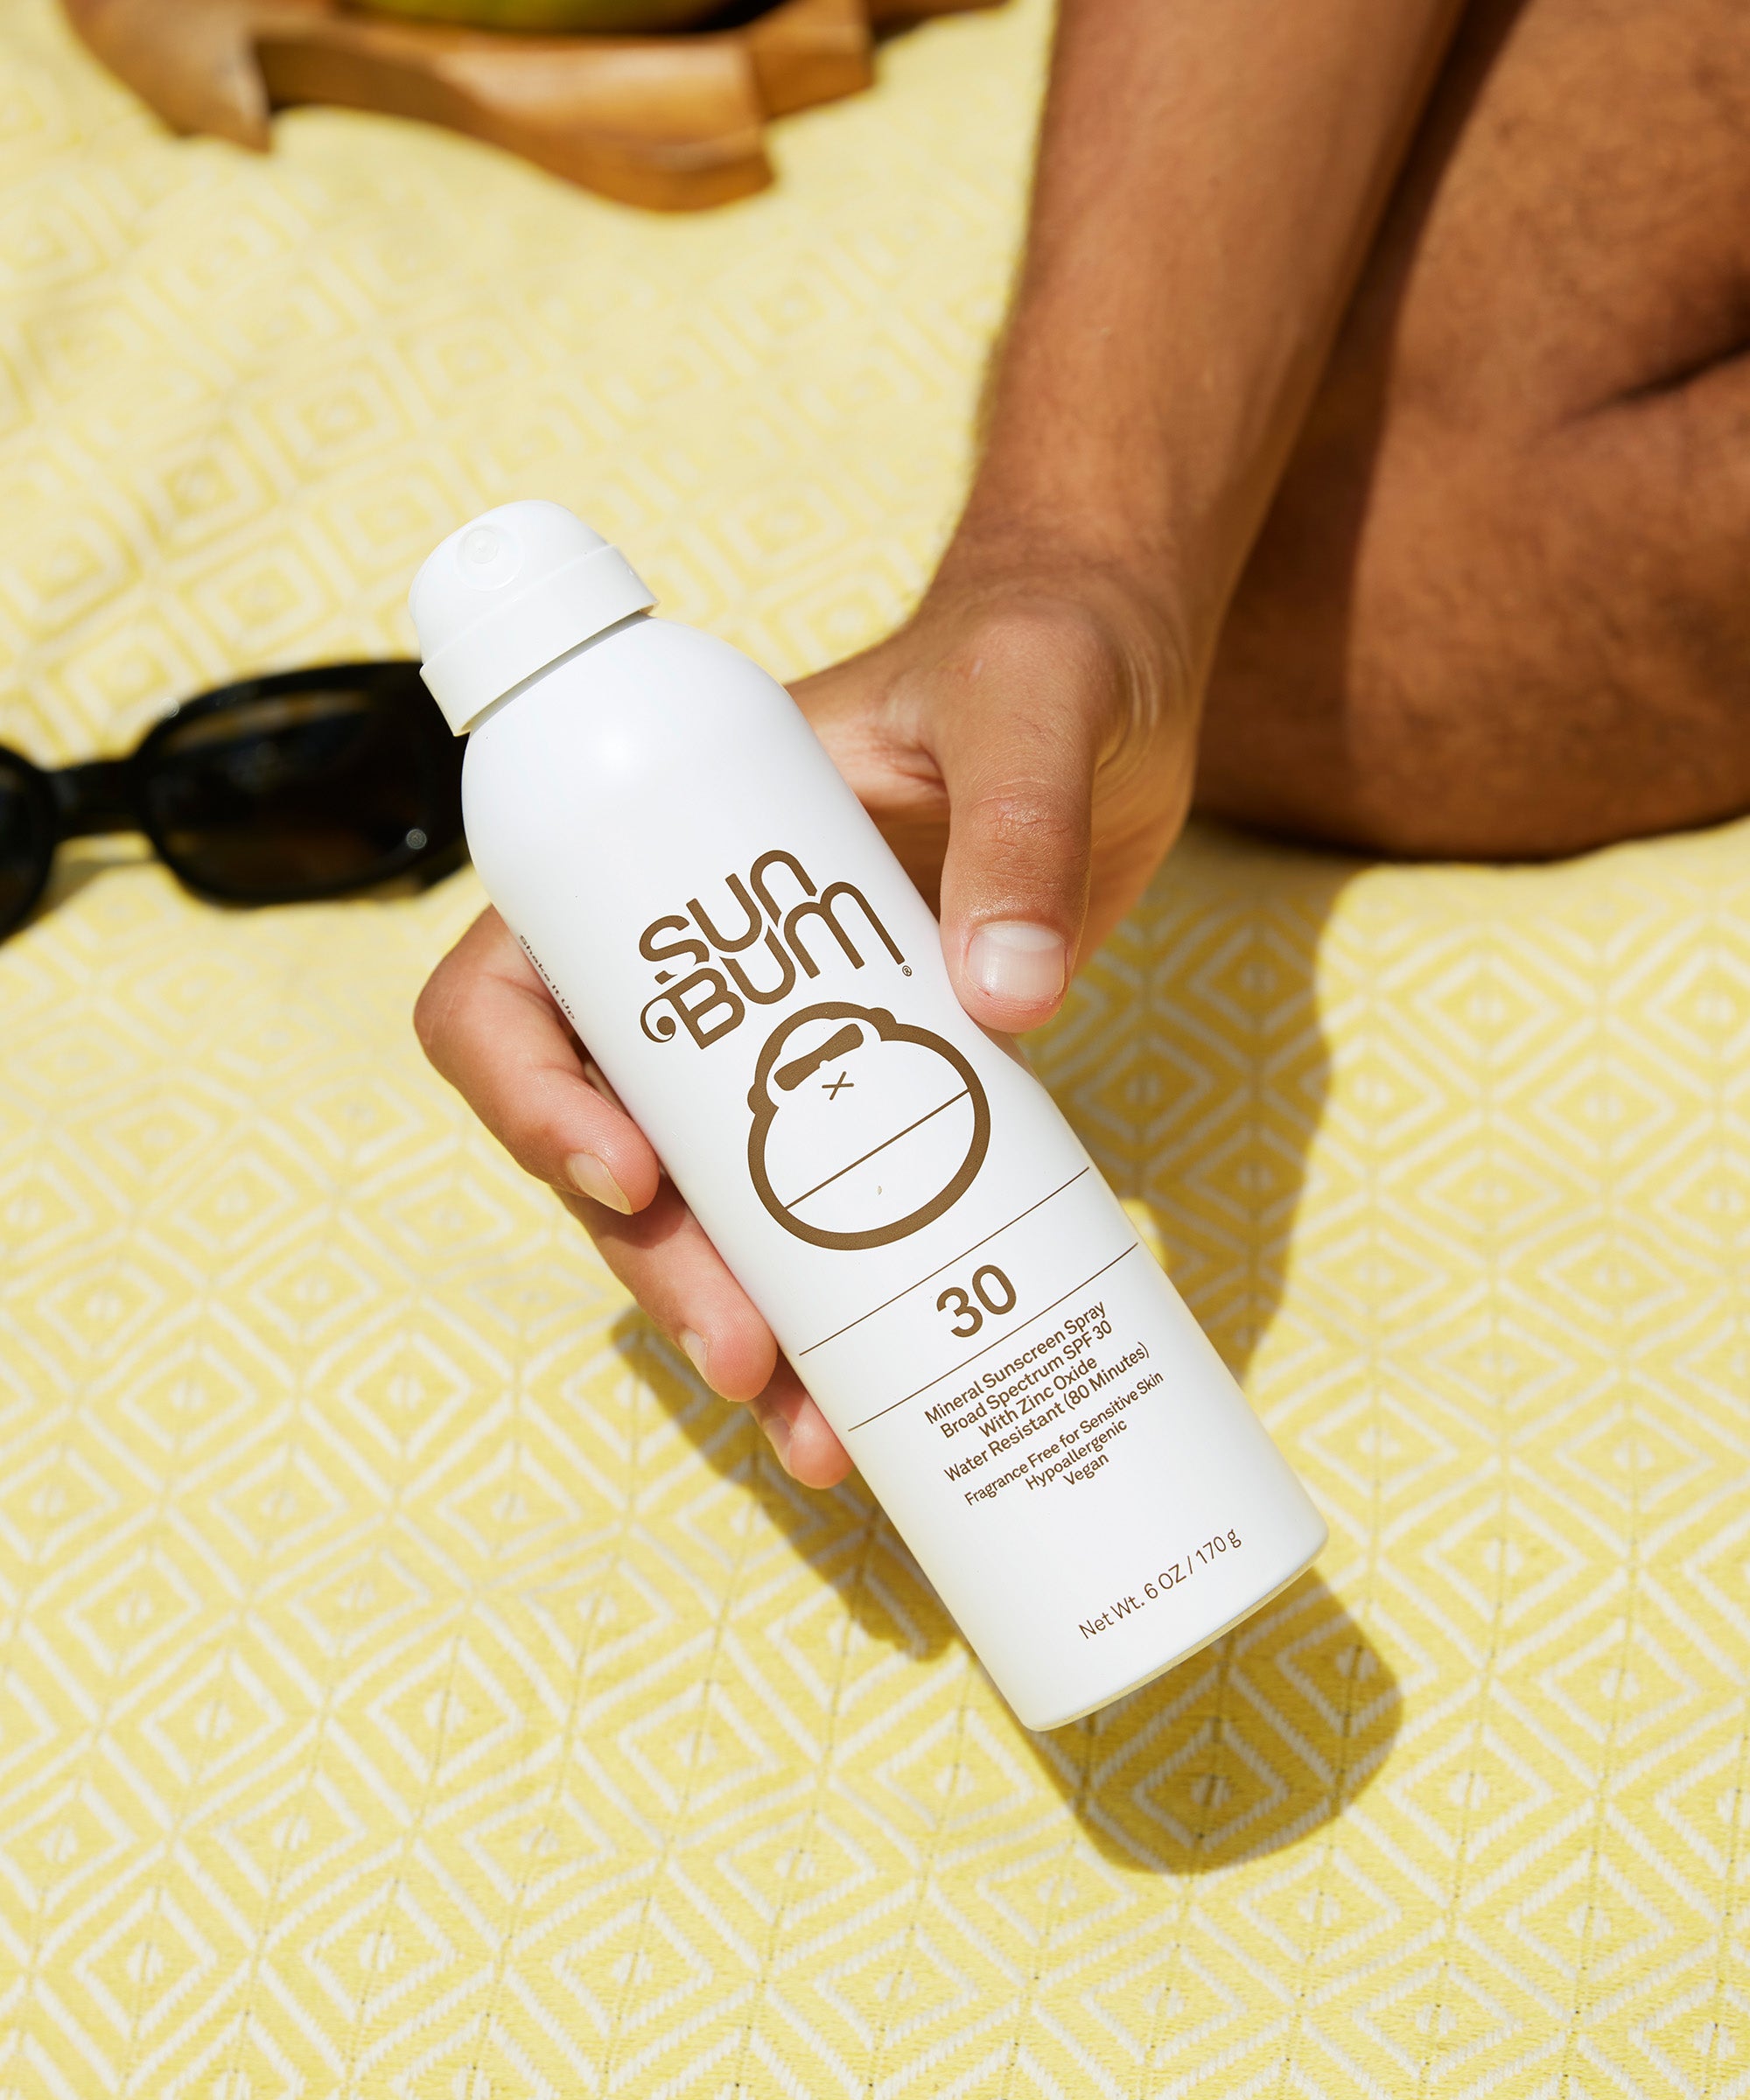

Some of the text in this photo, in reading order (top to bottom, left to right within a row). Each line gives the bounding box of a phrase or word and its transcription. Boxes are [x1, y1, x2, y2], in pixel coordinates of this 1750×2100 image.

[936, 1264, 1017, 1338] 30
[924, 1301, 1106, 1425] Mineral Sunscreen Spray
[940, 1320, 1112, 1439] Broad Spectrum SPF 30
[944, 1340, 1150, 1482] Water Resistant (80 Minutes)
[978, 1357, 1098, 1438] With Zinc Oxide
[964, 1373, 1164, 1507] Fragrance Free for Sensitive Skin
[1026, 1419, 1128, 1491] Hypoallergenic
[1062, 1454, 1110, 1486] Vegan
[1079, 1613, 1115, 1640] Net
[1110, 1596, 1145, 1620] Wt.
[1144, 1583, 1158, 1600] 6
[1158, 1564, 1187, 1590] OZ
[1195, 1536, 1227, 1564] 170
[1227, 1529, 1242, 1549] g
